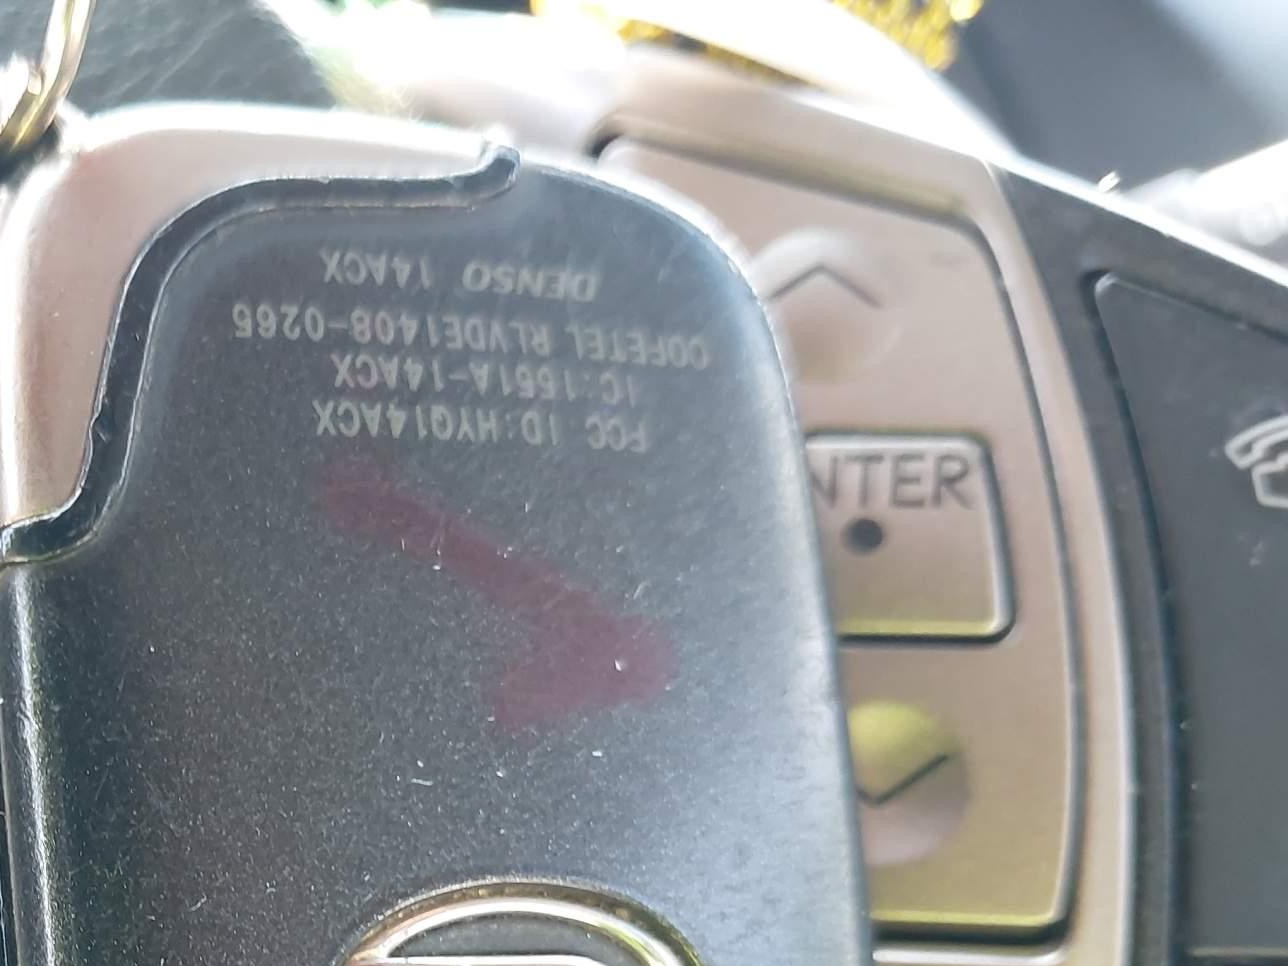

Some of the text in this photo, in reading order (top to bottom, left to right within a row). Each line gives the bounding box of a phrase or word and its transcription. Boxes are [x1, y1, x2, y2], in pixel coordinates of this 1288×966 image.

[319, 248, 597, 301] DENSO 14ACX
[231, 302, 550, 357] RLVDE1408-0265
[585, 414, 647, 453] FCC
[812, 453, 975, 509] NTER
